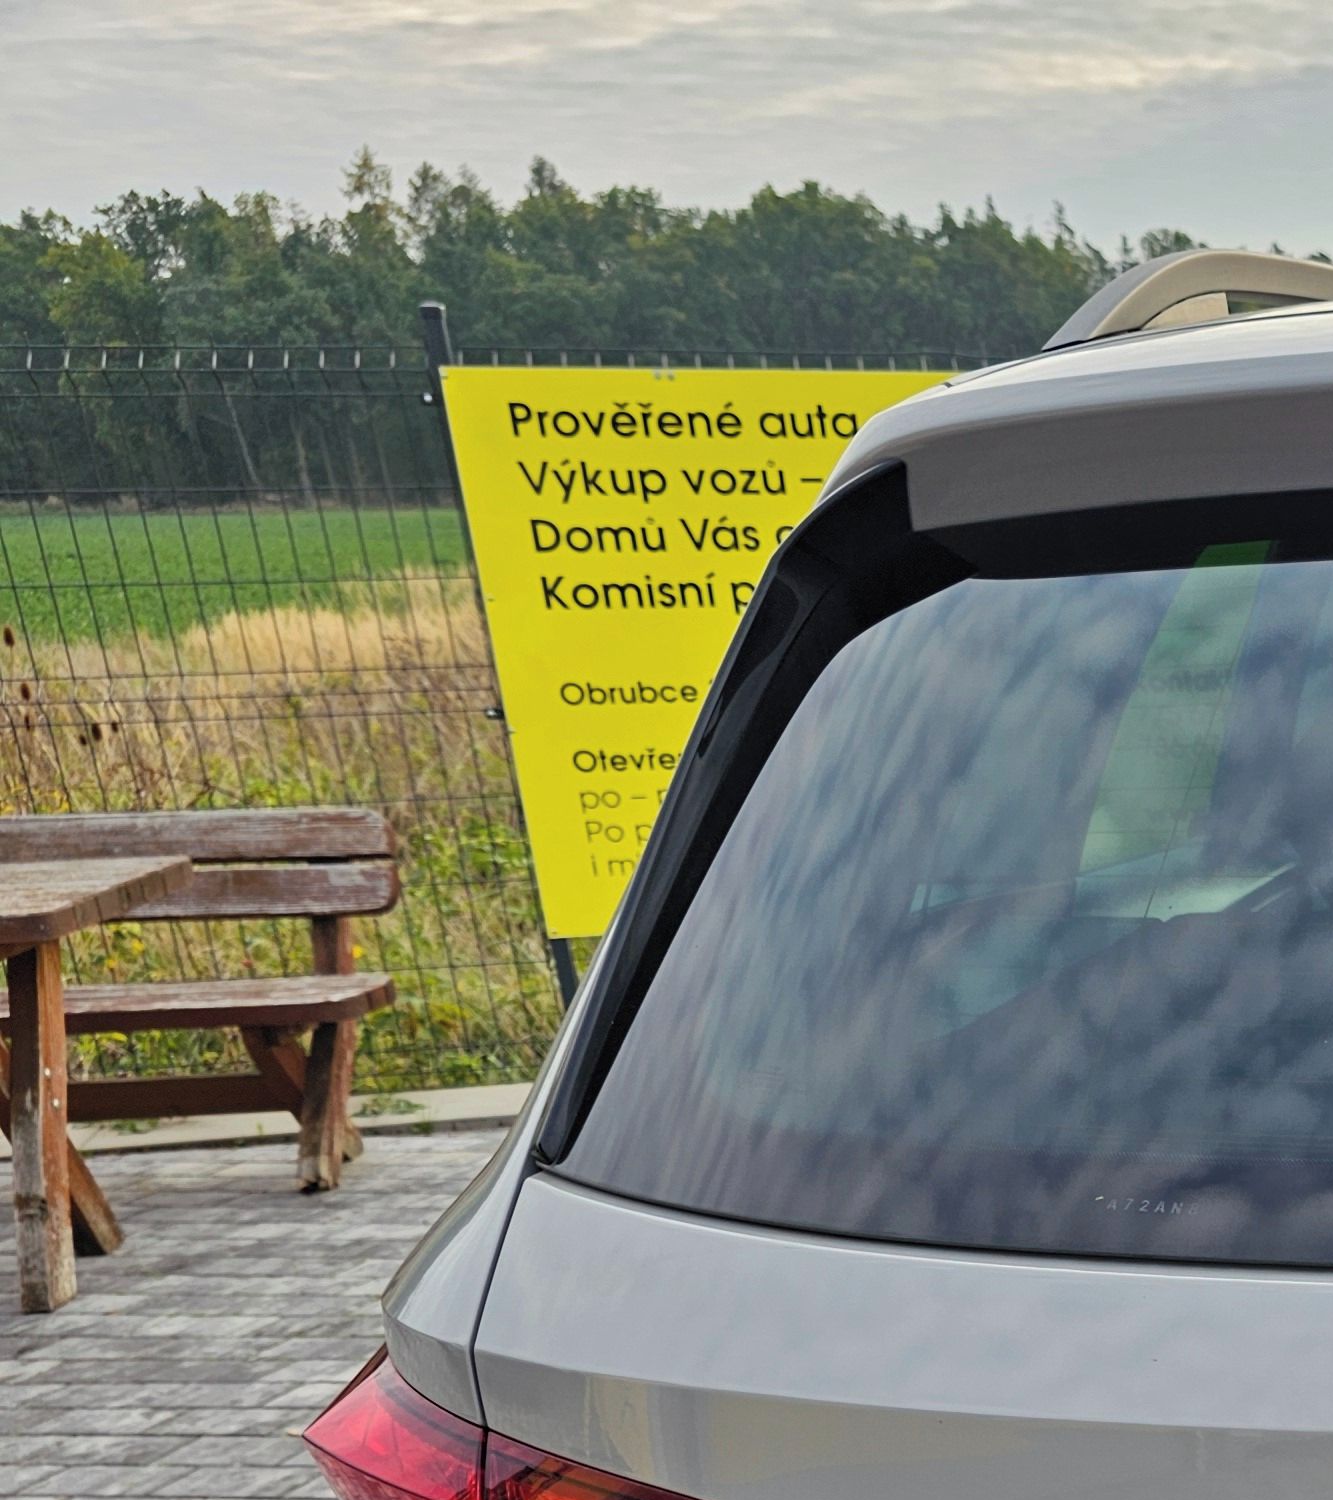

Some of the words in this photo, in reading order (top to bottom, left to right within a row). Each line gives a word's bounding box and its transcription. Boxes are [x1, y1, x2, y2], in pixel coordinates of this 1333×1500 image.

[508, 402, 742, 438] Prověřené
[759, 405, 858, 438] auta
[517, 459, 667, 503] Výkup
[682, 460, 787, 495] vozů
[531, 517, 667, 553] Domů
[679, 516, 760, 552] Vás
[541, 572, 716, 610] Komisní
[560, 682, 698, 706] Obrubce
[573, 748, 682, 773] Otevře
[580, 790, 621, 814] po
[585, 821, 625, 843] Po
